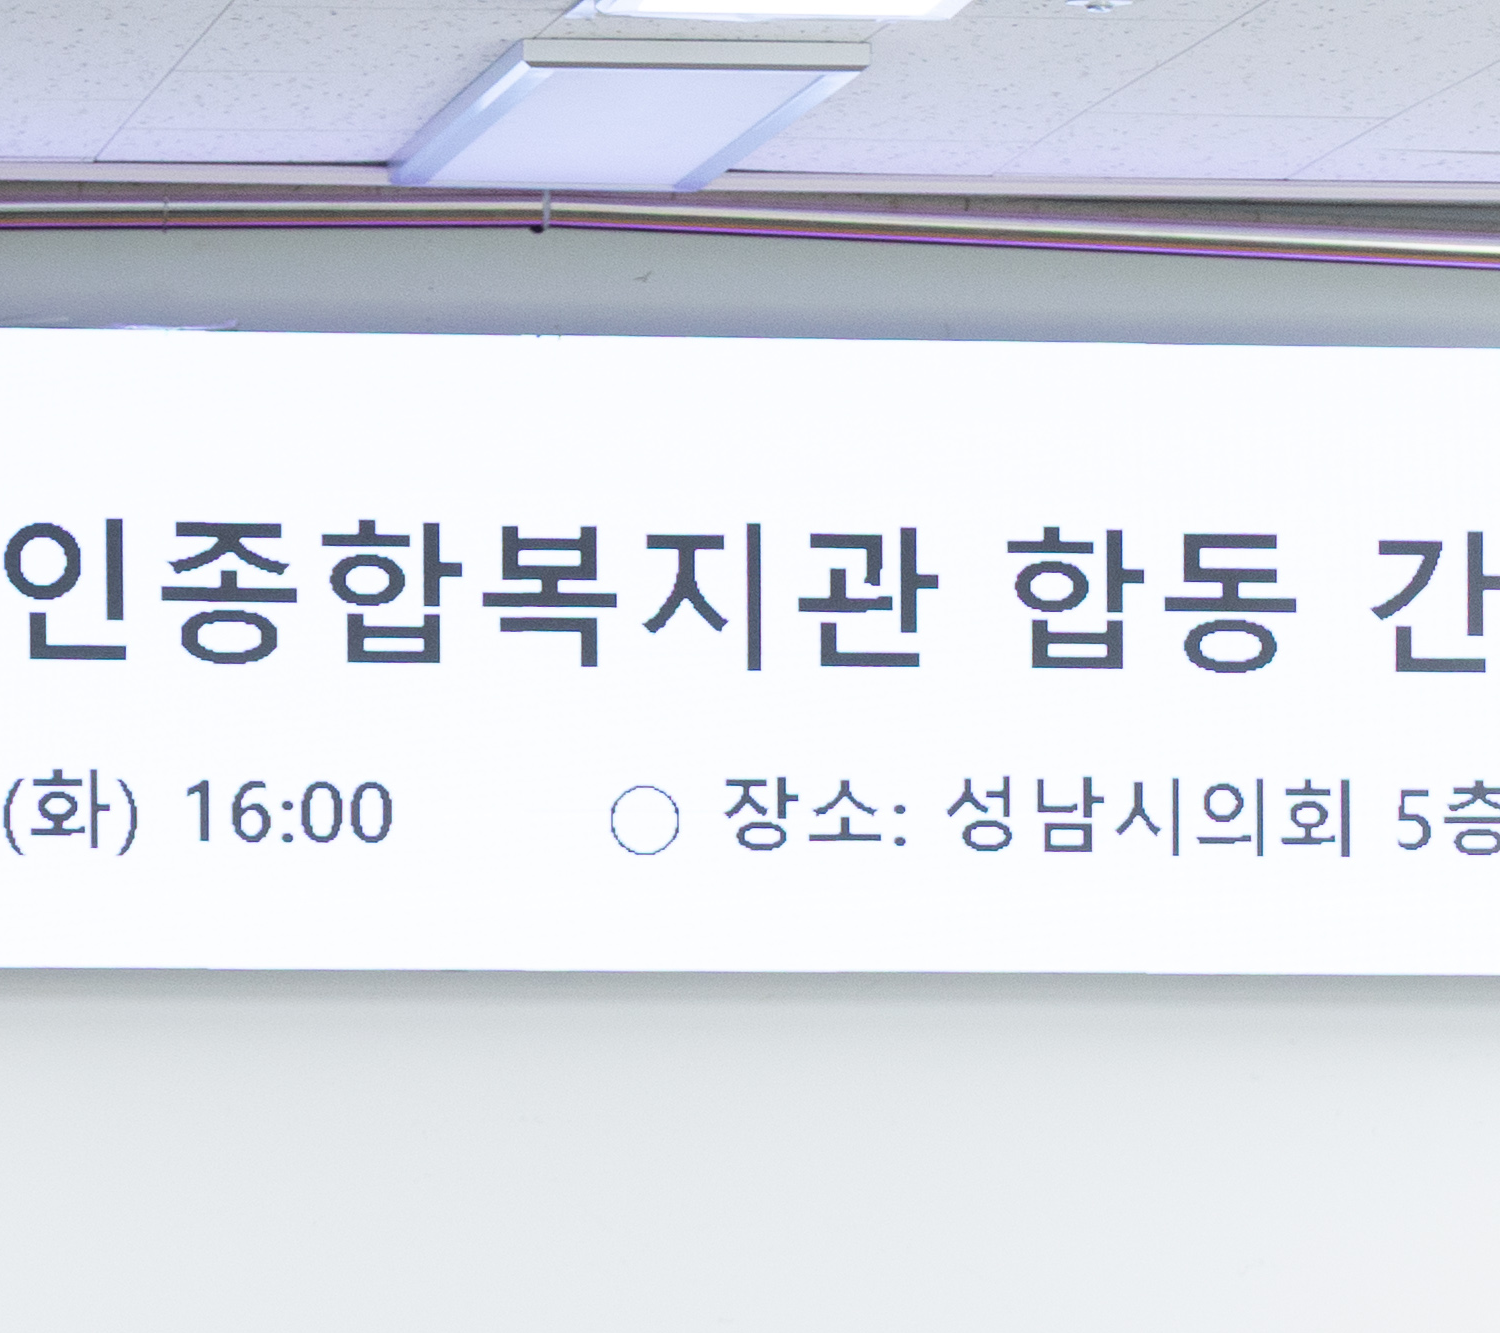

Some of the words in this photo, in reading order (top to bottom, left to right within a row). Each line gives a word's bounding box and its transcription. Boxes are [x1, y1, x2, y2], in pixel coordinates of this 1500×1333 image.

[1005, 524, 1297, 675] 합동
[185, 778, 393, 844] 16:00
[723, 774, 907, 853] 장소:
[945, 774, 1351, 858] 성남시의회
